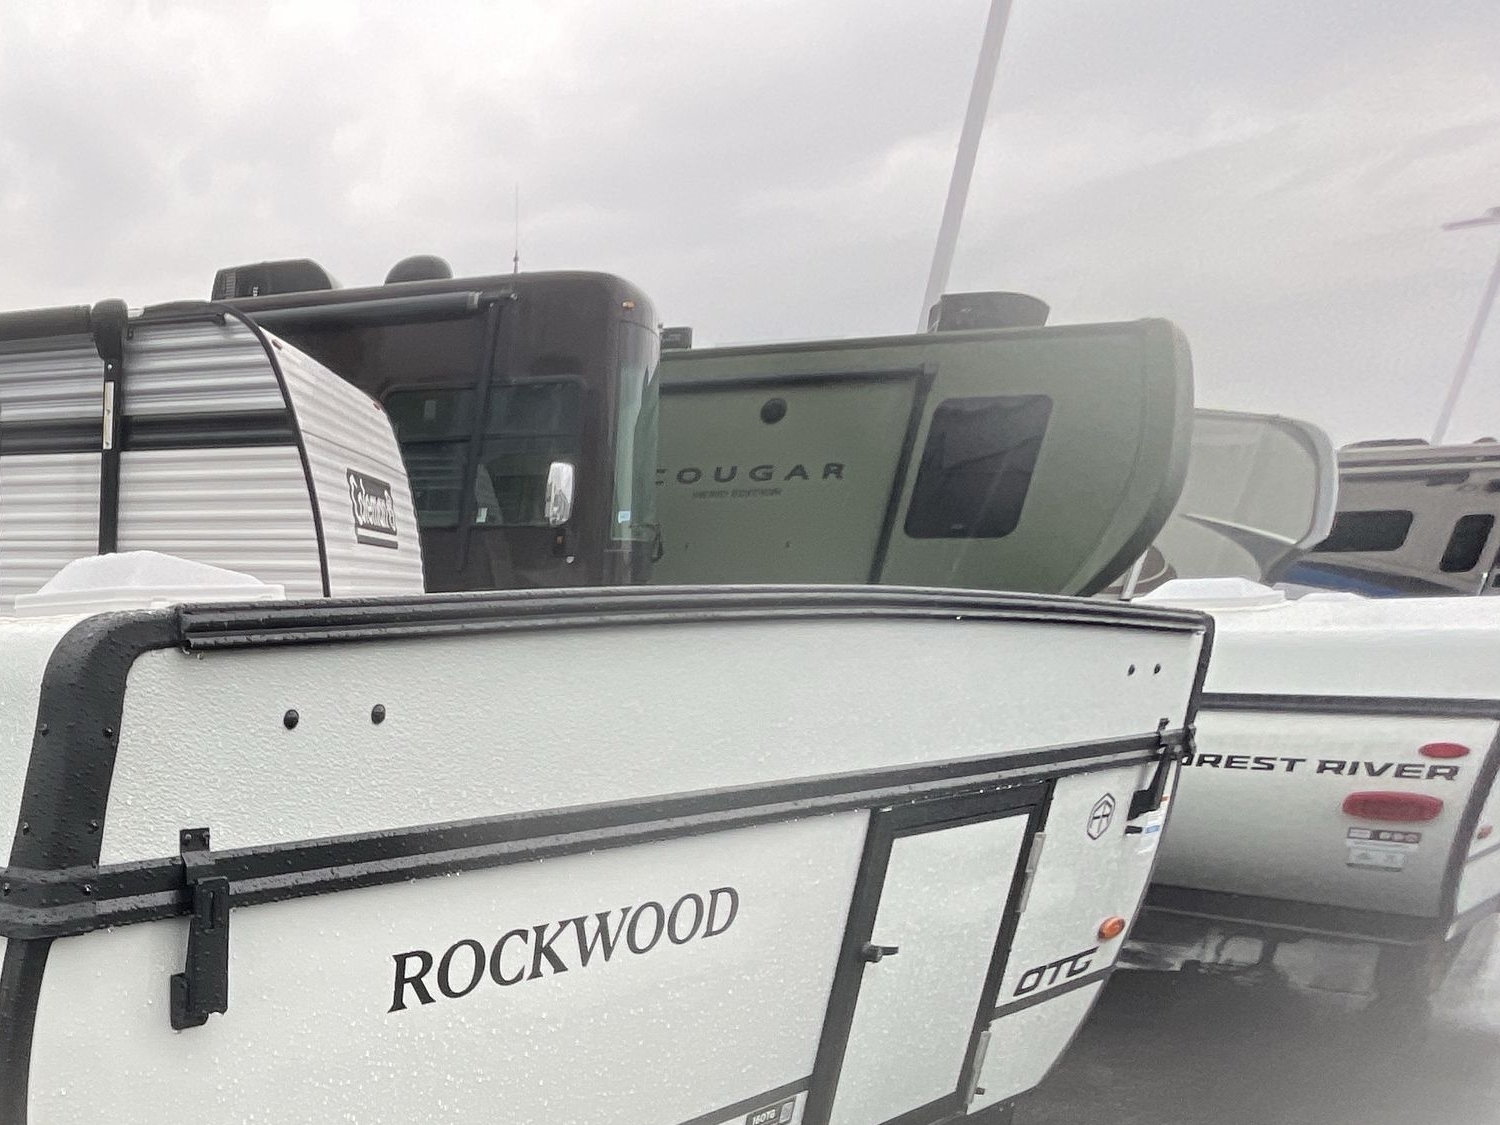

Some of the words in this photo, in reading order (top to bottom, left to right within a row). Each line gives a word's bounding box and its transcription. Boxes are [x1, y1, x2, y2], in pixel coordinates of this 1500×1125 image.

[1316, 759, 1460, 781] RIVER
[387, 886, 740, 1014] ROCKWOOD
[1013, 945, 1100, 997] OTG
